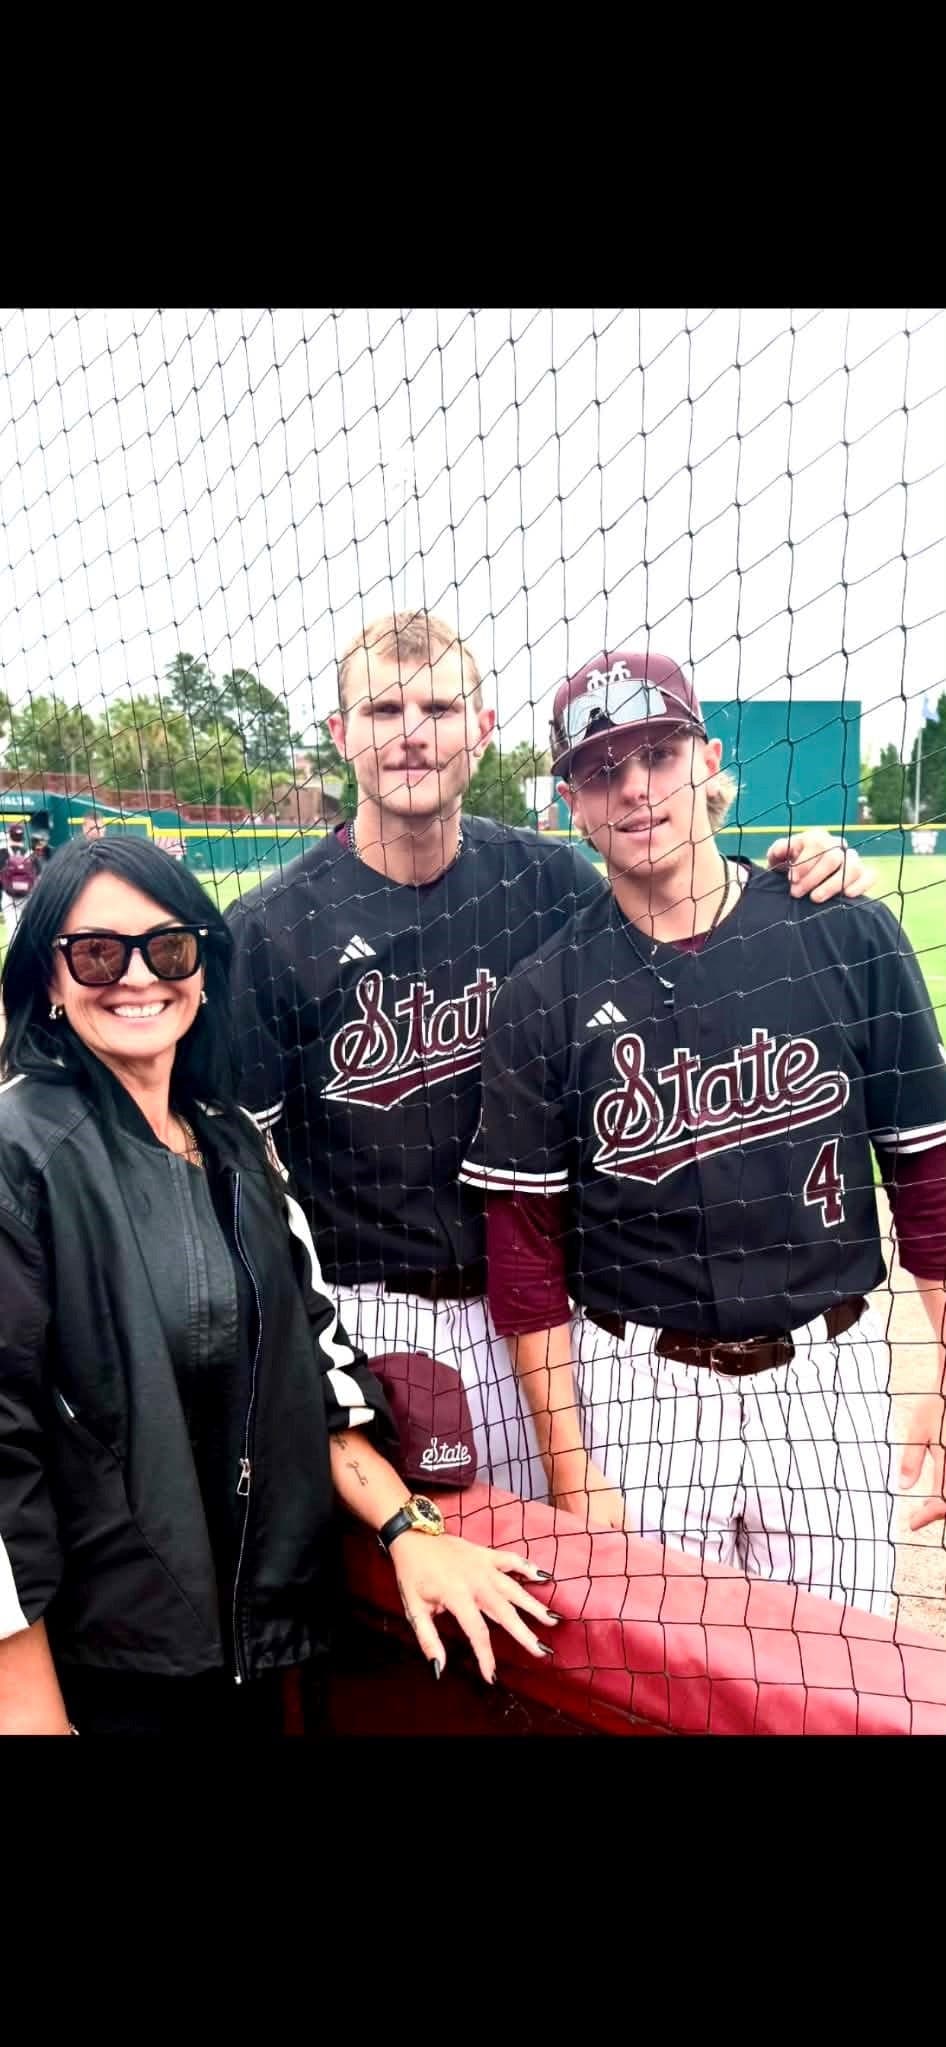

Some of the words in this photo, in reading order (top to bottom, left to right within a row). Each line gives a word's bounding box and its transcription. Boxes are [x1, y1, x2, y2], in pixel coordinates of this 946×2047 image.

[320, 968, 500, 1093] Stat
[592, 1028, 850, 1163] State
[803, 1138, 845, 1228] 4
[420, 1437, 472, 1465] State
